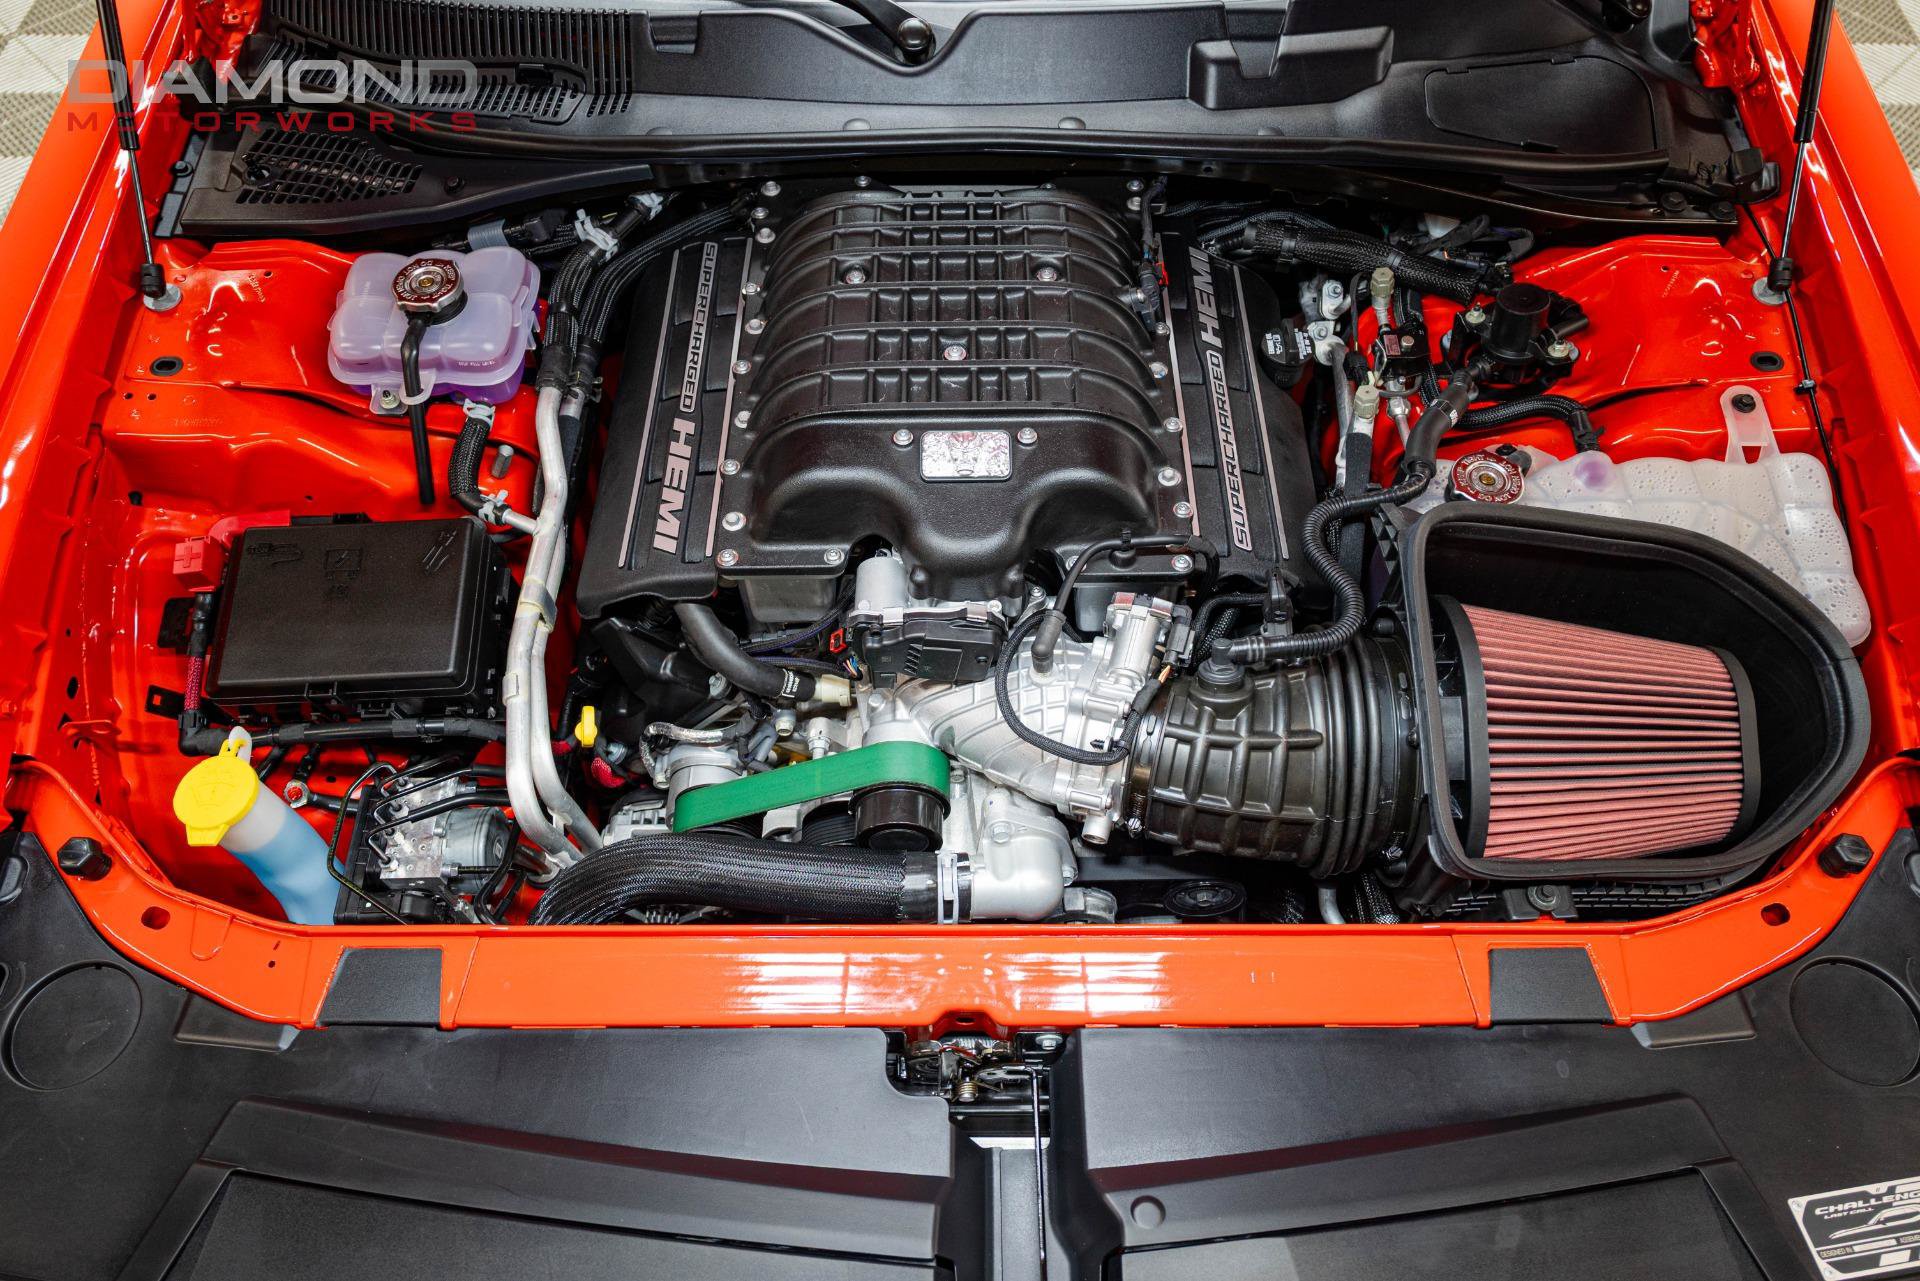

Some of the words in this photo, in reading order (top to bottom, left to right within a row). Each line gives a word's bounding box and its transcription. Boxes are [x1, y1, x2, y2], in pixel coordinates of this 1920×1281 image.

[682, 242, 717, 412] SUPERCHARGED
[1188, 246, 1223, 349] HEMI
[653, 417, 696, 554] HEMI
[1208, 352, 1250, 549] SUPERCHARGED
[1823, 1211, 1849, 1220] LAST
[1850, 1207, 1875, 1216] CALL
